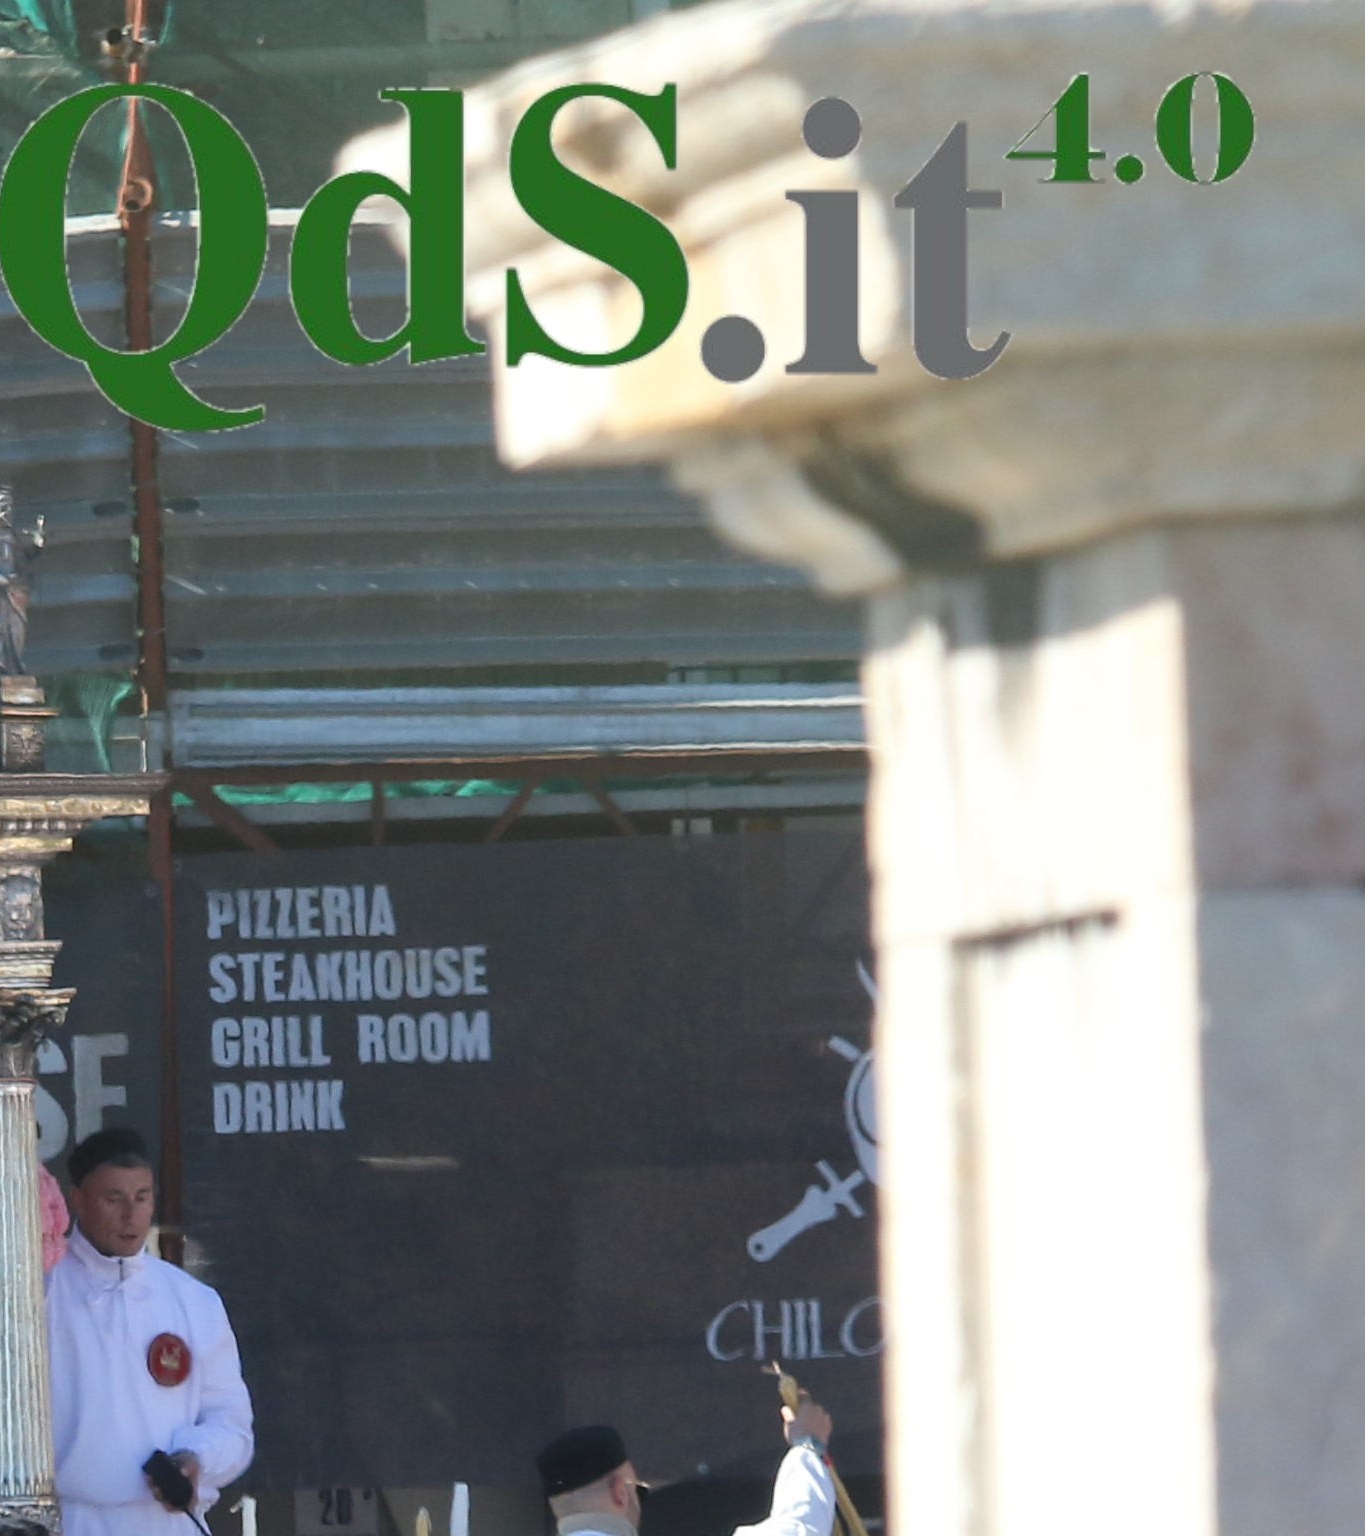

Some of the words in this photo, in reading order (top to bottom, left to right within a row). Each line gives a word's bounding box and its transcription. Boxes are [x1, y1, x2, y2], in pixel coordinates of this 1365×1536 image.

[206, 884, 396, 940] PIZZERIA
[208, 945, 489, 1004] STEAKHOUSE
[210, 1014, 332, 1068] GRILL
[357, 1010, 491, 1064] ROOM
[212, 1079, 346, 1135] DRINK
